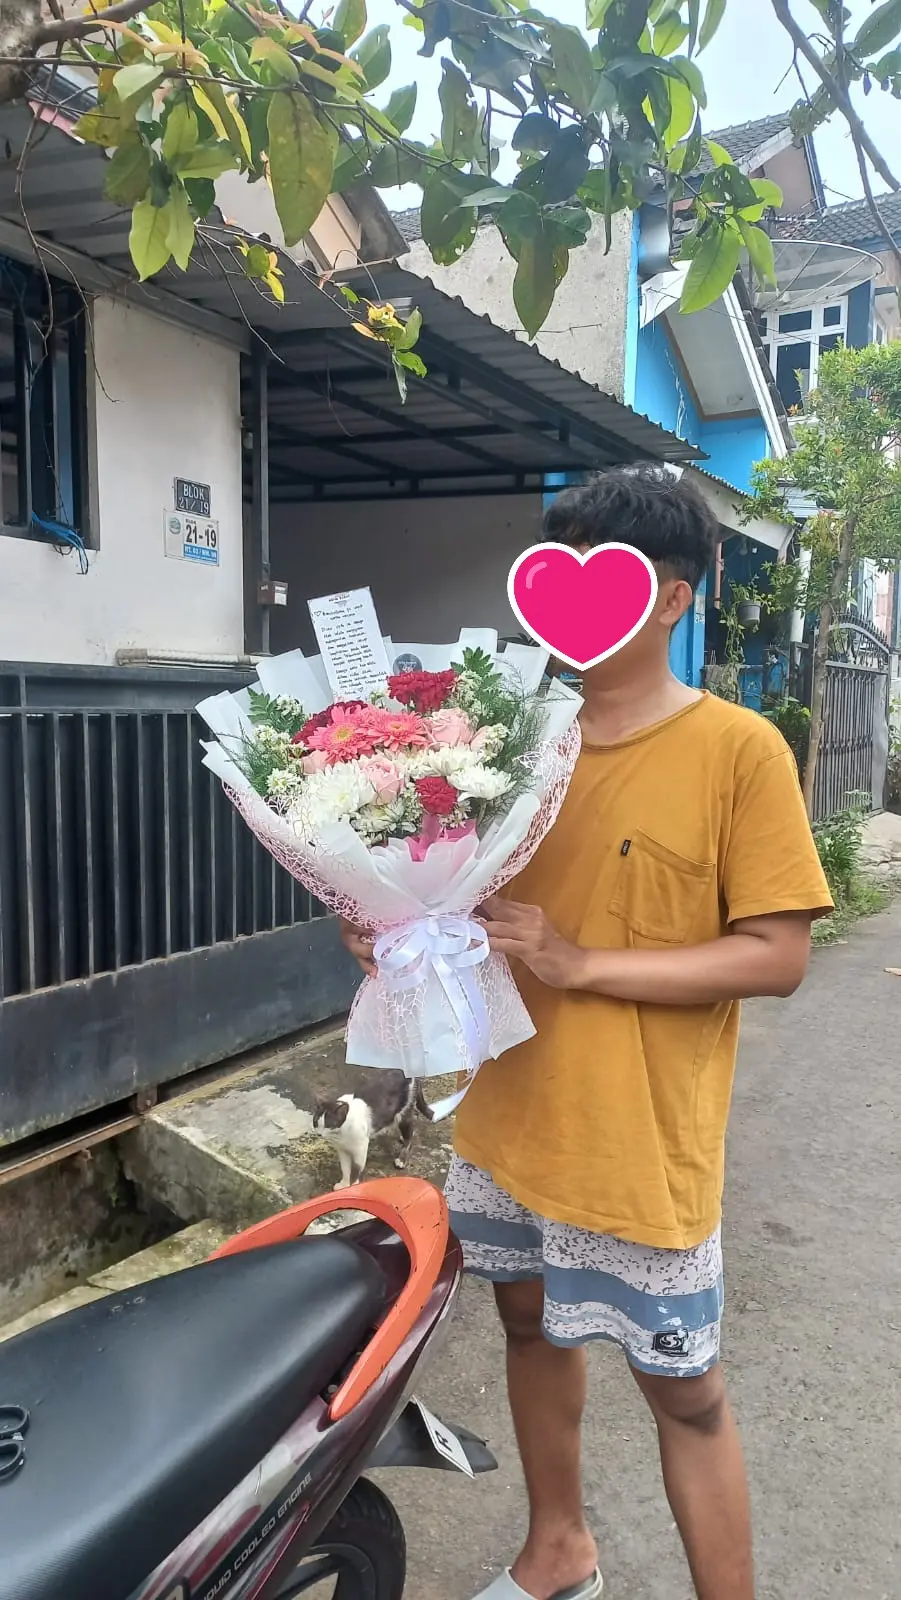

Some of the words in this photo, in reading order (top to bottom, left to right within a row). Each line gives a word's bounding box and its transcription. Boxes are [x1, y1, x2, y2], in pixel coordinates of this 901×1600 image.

[183, 484, 205, 501] BLOK
[186, 523, 216, 548] 21-19
[434, 1430, 453, 1452] R
[234, 1516, 276, 1570] COOLED
[277, 1472, 312, 1518] ENGINE
